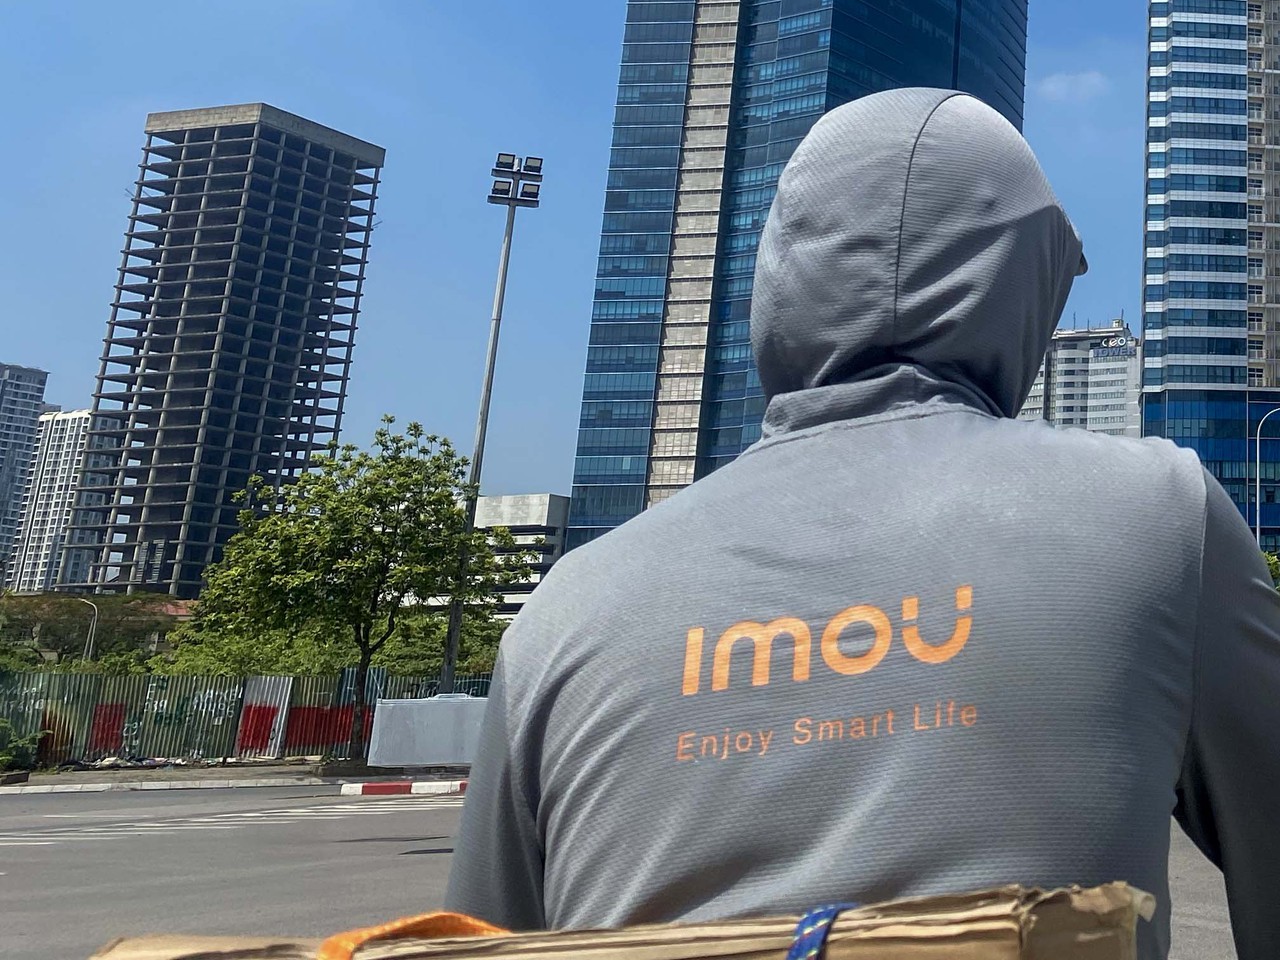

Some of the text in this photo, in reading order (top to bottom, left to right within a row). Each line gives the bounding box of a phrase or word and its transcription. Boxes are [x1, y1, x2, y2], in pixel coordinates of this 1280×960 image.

[676, 699, 978, 761] Enjoy Smart Life
